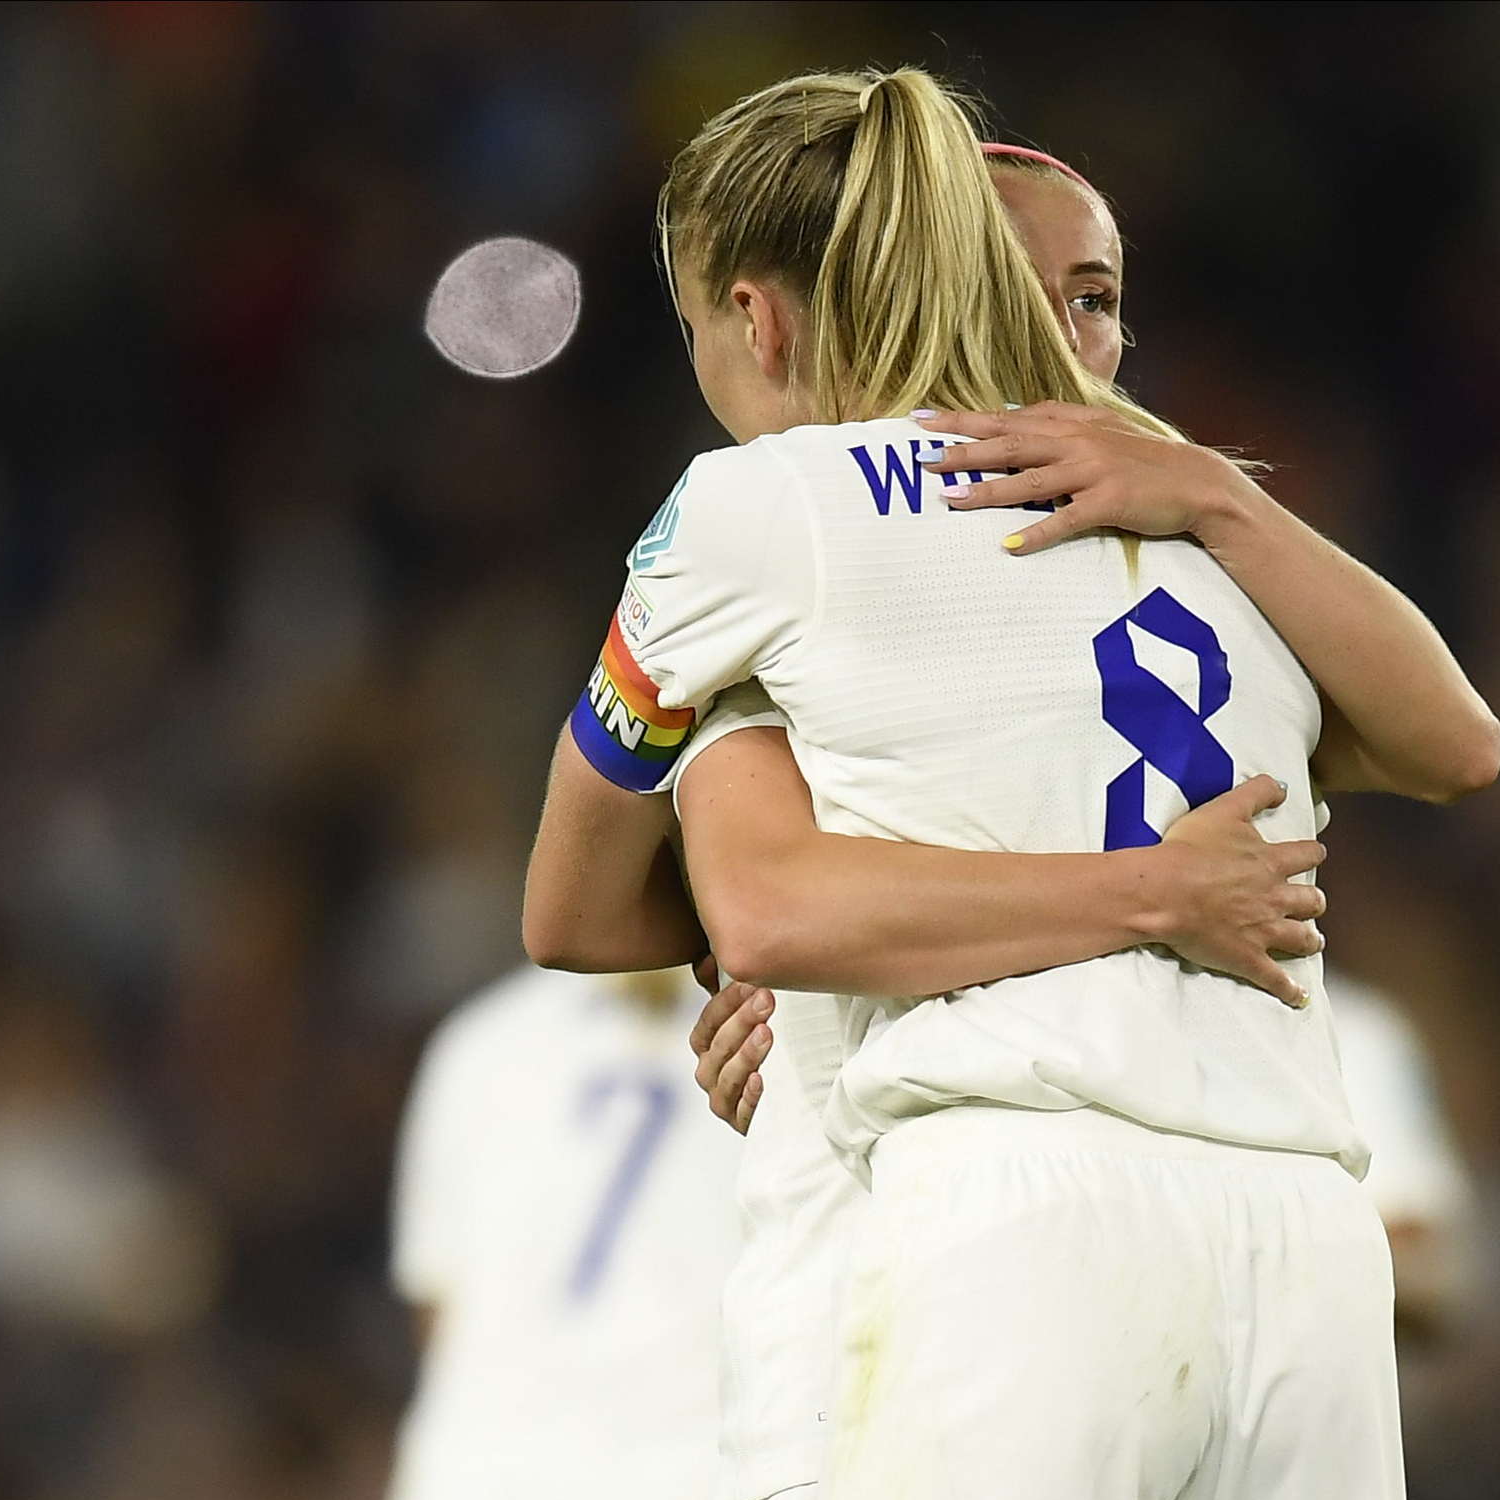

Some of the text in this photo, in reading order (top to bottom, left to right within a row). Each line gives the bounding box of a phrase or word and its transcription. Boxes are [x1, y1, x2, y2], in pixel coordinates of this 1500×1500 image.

[624, 586, 650, 631] TION
[588, 660, 646, 752] AIN
[1092, 586, 1232, 852] 8
[570, 1065, 682, 1312] 7
